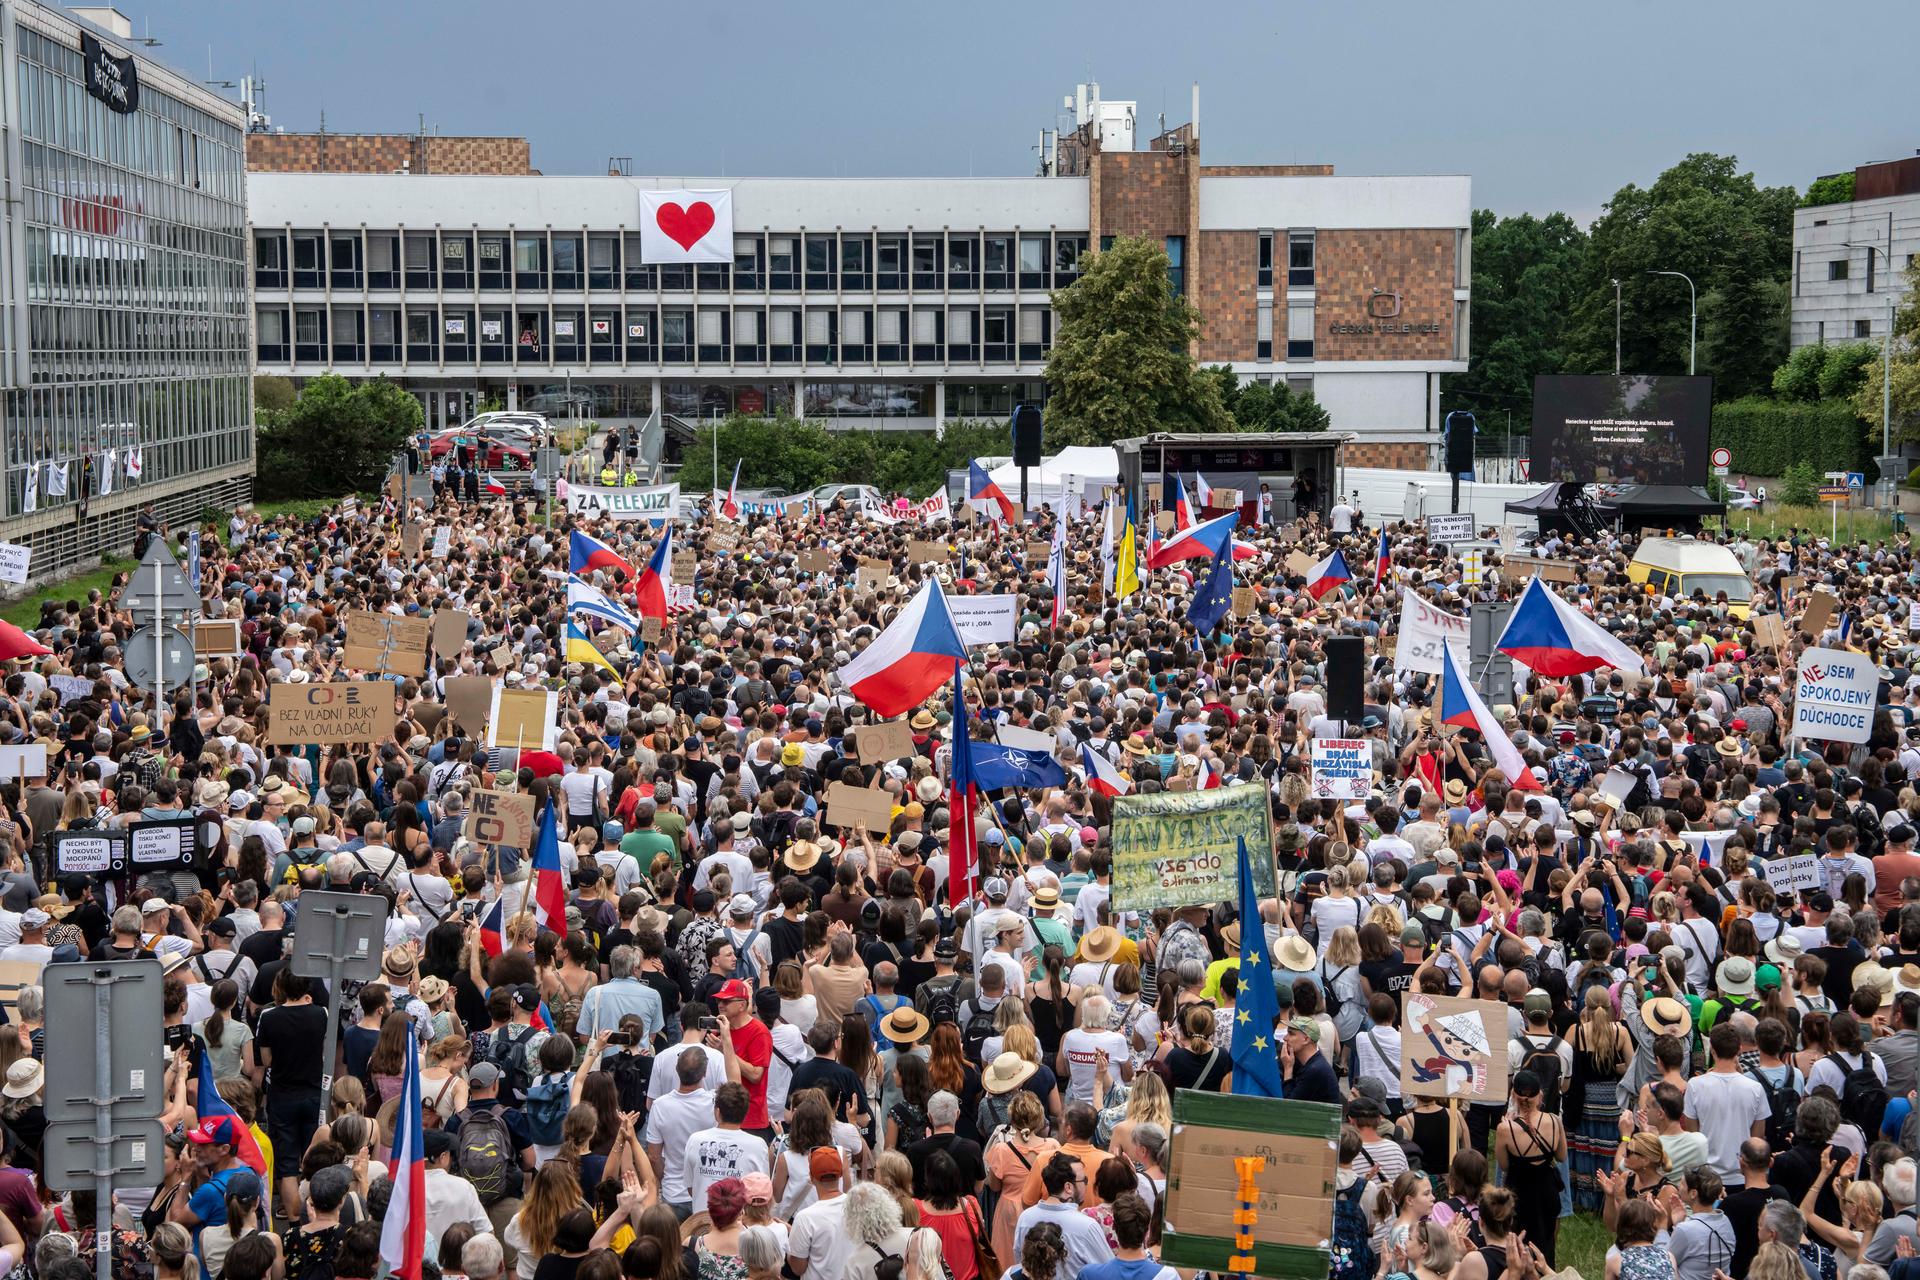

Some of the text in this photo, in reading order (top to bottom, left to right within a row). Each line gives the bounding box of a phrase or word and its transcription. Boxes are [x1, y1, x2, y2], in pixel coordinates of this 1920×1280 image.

[1378, 322, 1439, 334] TELEVIZE
[578, 493, 670, 510] ZA TELEVIZI
[865, 496, 881, 514] ZA
[1800, 684, 1872, 705] SPOKOJENÝ
[280, 706, 378, 721] BEZ VLÁDNÍ RUKY
[1800, 706, 1865, 728] DŮCHODCE
[289, 720, 372, 737] NA OVLADAČI
[1319, 740, 1365, 750] LIBEREC
[1326, 749, 1359, 759] BRÁNÍ
[1313, 758, 1372, 769] NEZÁVISLÁ
[1326, 768, 1359, 778] MÉDIA
[473, 793, 499, 816] NE
[66, 854, 102, 862] MOCIPÁNŮ
[1768, 864, 1788, 874] Chci
